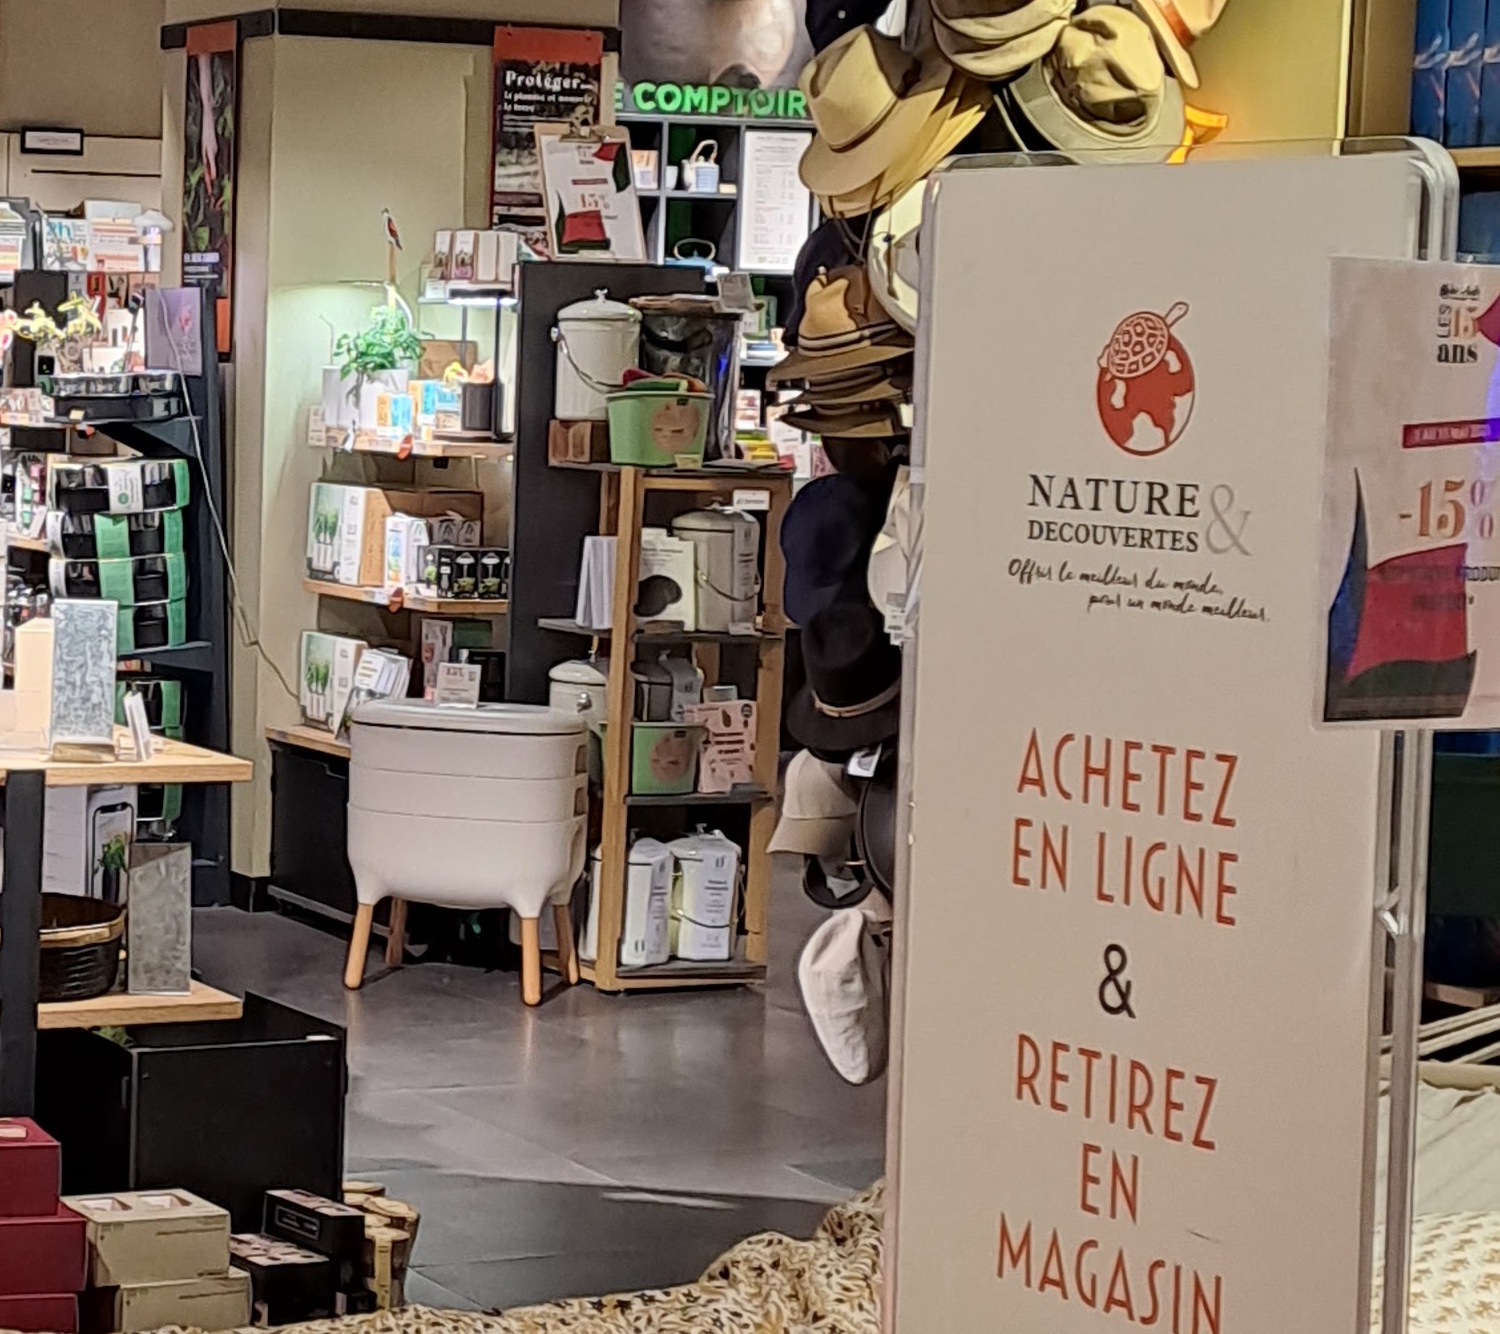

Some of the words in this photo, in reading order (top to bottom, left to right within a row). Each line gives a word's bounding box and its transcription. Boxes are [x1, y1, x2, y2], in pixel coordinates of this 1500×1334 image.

[633, 82, 807, 117] COMPTOIR
[1436, 343, 1478, 364] ans
[1027, 473, 1200, 518] NATURE
[1205, 483, 1253, 556] &
[1027, 519, 1199, 553] DECOUVERTES
[1398, 478, 1495, 541] -15%
[1150, 593, 1198, 614] monde
[1017, 727, 1238, 828] ACHETEZ
[1012, 817, 1069, 893] EN
[1096, 831, 1238, 926] LIGNE
[1098, 943, 1137, 1019] &
[1016, 1033, 1218, 1151] RETIREZ
[1080, 1142, 1139, 1225] EN
